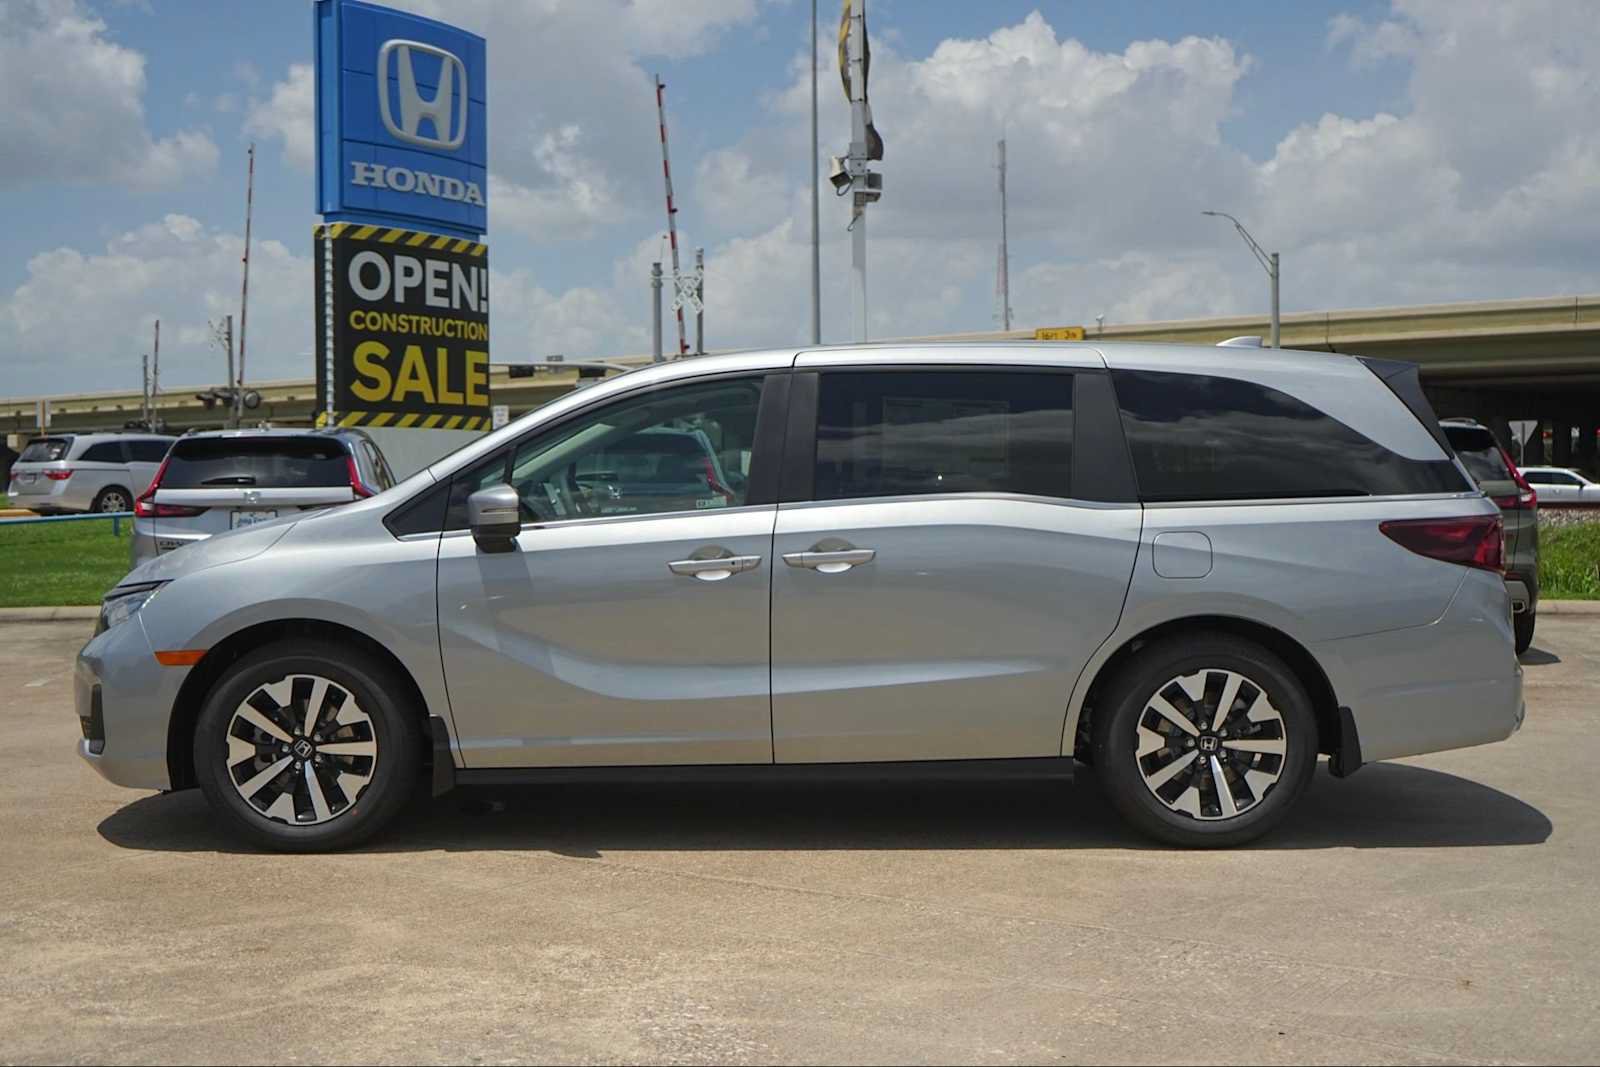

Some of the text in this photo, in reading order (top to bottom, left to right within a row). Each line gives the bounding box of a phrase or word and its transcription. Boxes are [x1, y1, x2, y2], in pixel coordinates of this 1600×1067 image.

[351, 161, 485, 207] HONDA
[348, 250, 488, 313] OPEN!
[350, 309, 488, 341] CONSTRUCTION
[350, 340, 488, 406] SALE
